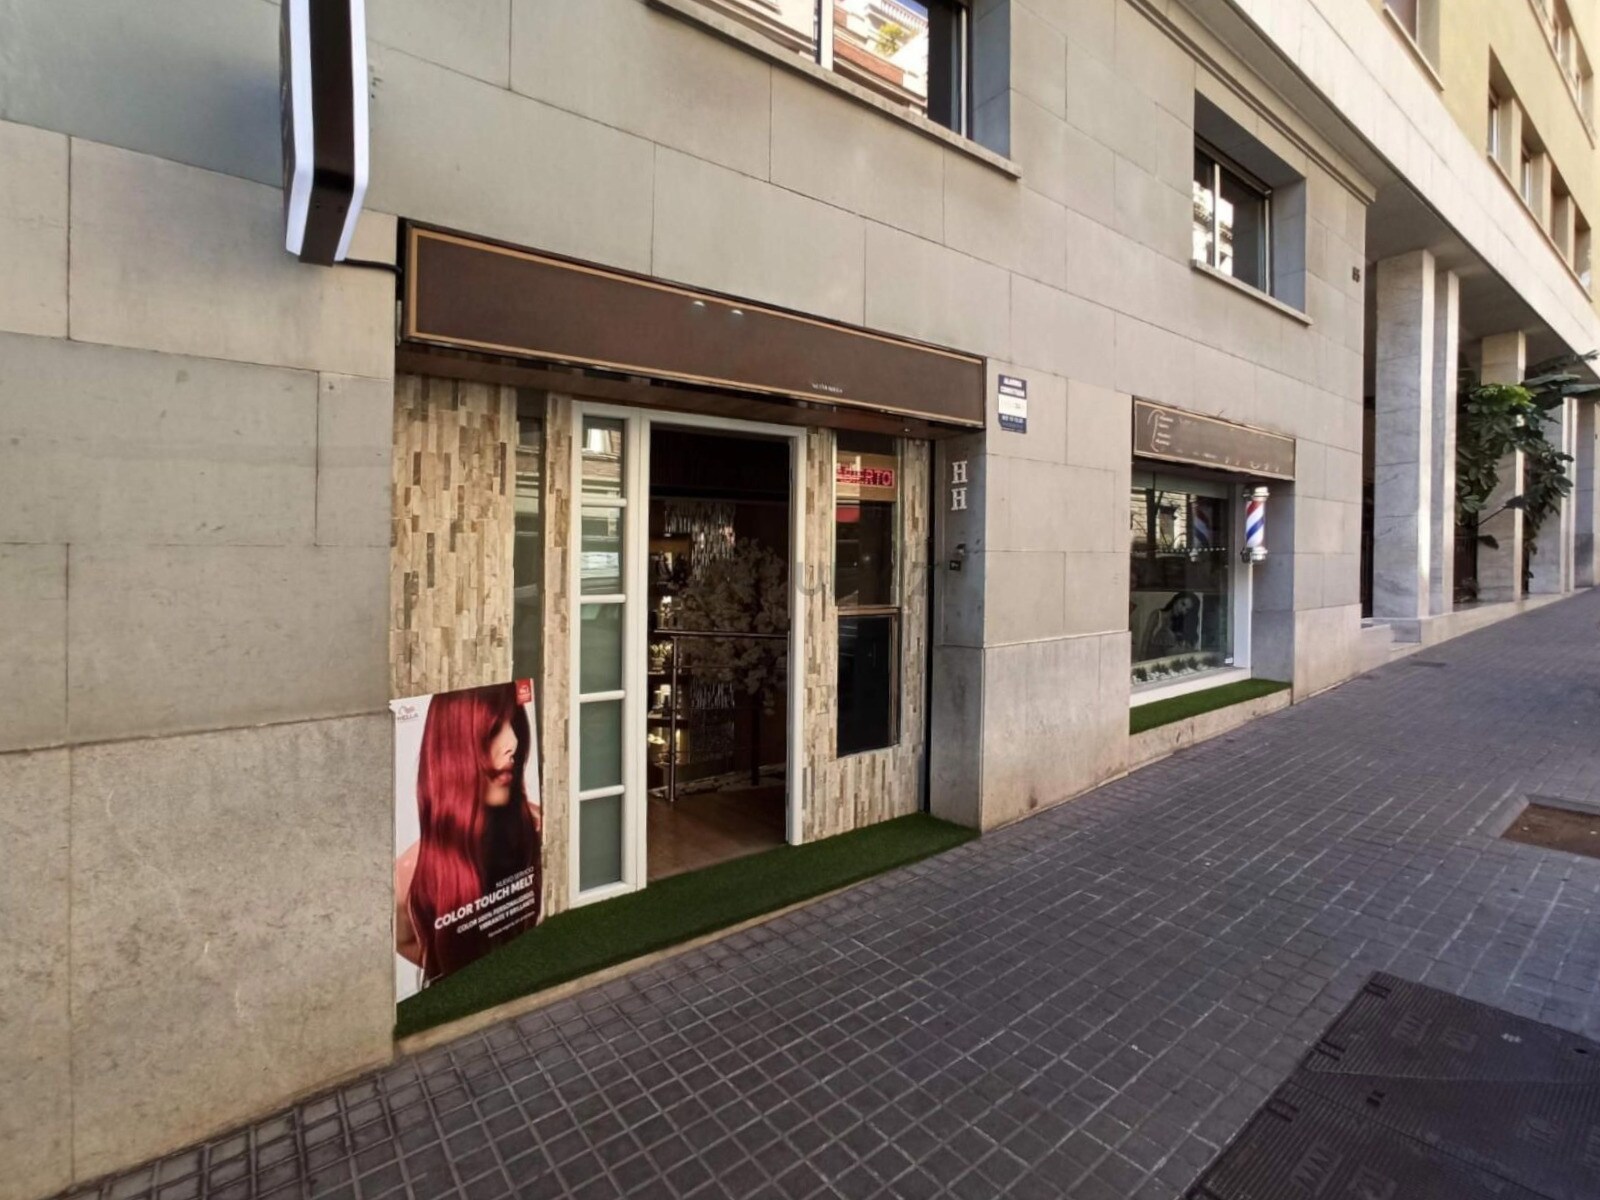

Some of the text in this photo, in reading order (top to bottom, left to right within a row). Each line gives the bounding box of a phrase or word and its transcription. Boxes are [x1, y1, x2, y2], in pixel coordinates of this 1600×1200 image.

[434, 903, 473, 930] COLOR
[474, 886, 510, 911] TOUCH
[511, 873, 535, 894] MELT
[456, 918, 478, 934] COLOR
